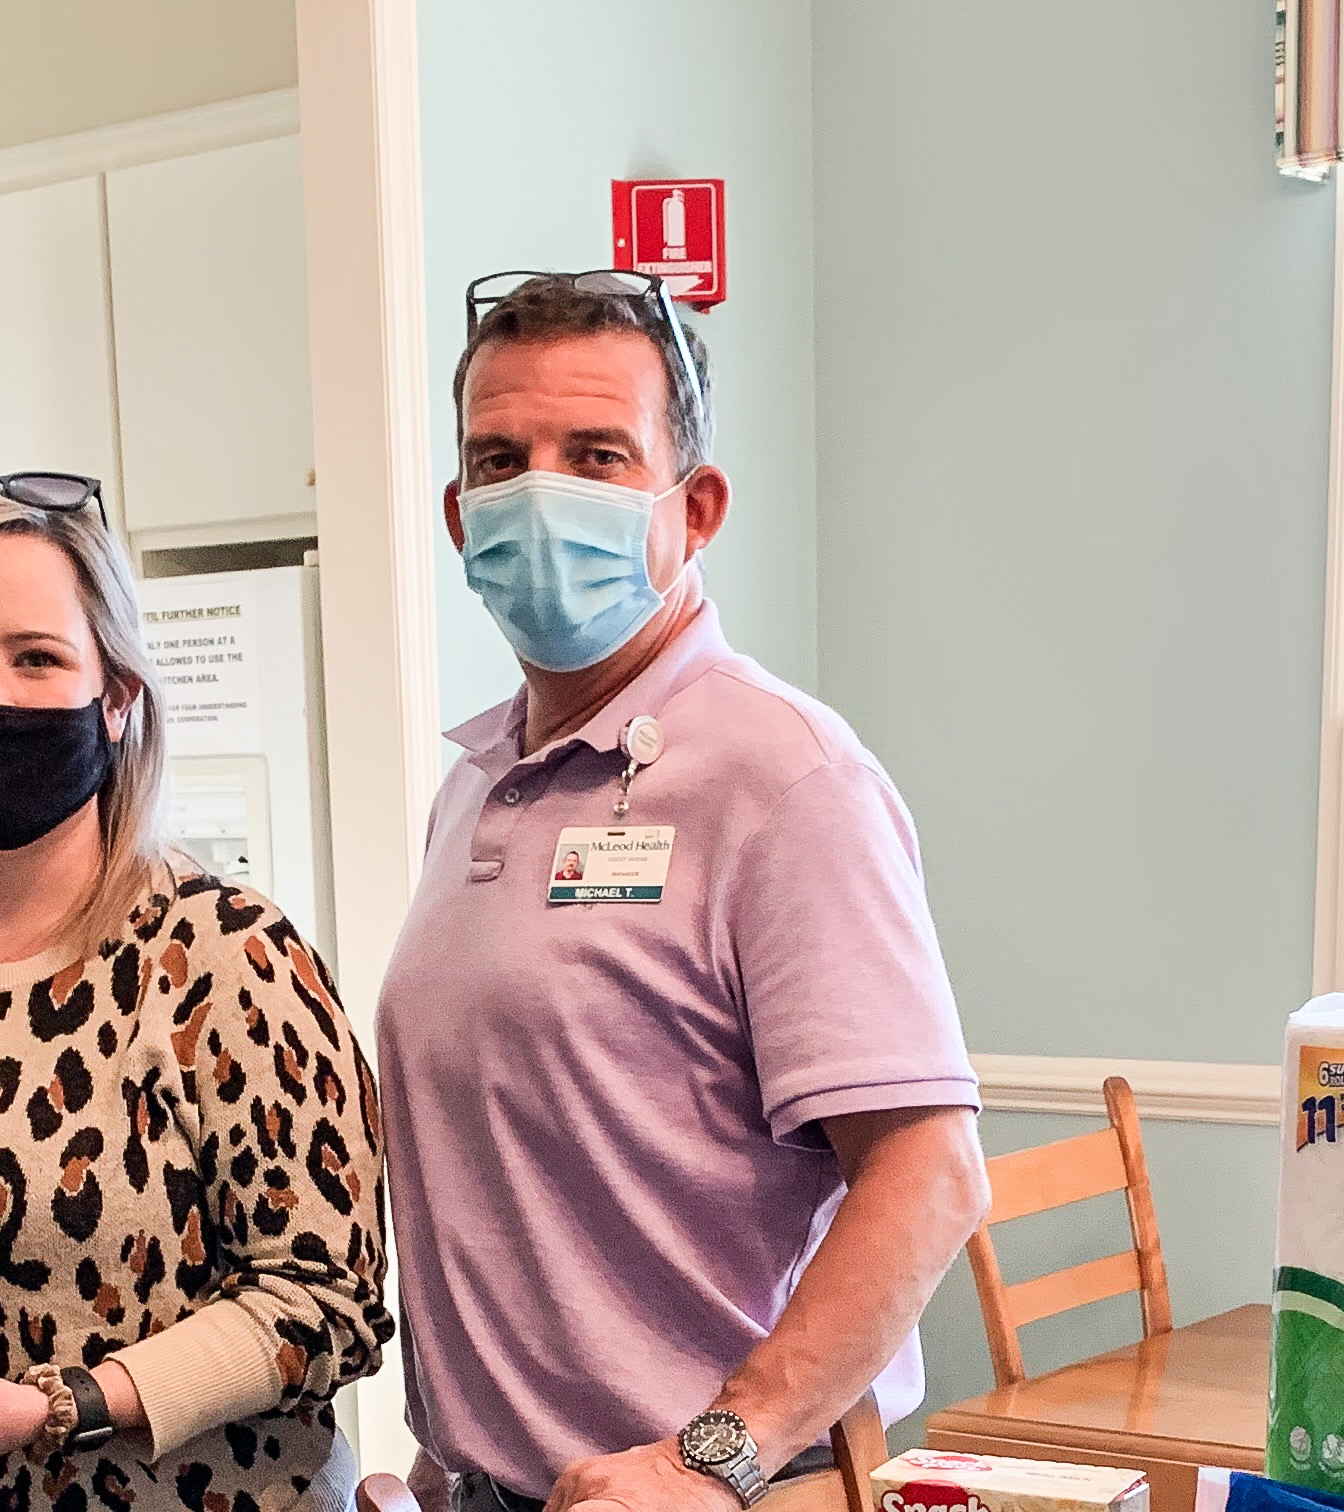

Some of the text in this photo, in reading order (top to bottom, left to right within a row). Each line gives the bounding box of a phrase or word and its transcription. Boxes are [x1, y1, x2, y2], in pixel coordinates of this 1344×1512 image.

[161, 605, 241, 620] FURTHER NOTICE
[163, 640, 179, 649] ONE
[182, 638, 215, 648] PERSON
[156, 655, 193, 667] ALLOWED
[195, 655, 207, 664] TO
[227, 652, 243, 663] THE
[163, 676, 193, 685] ITCHEN
[590, 839, 670, 852] McLeod Health
[574, 887, 623, 899] MICHAEL
[1318, 1061, 1330, 1087] 6
[1302, 1095, 1336, 1144] 11
